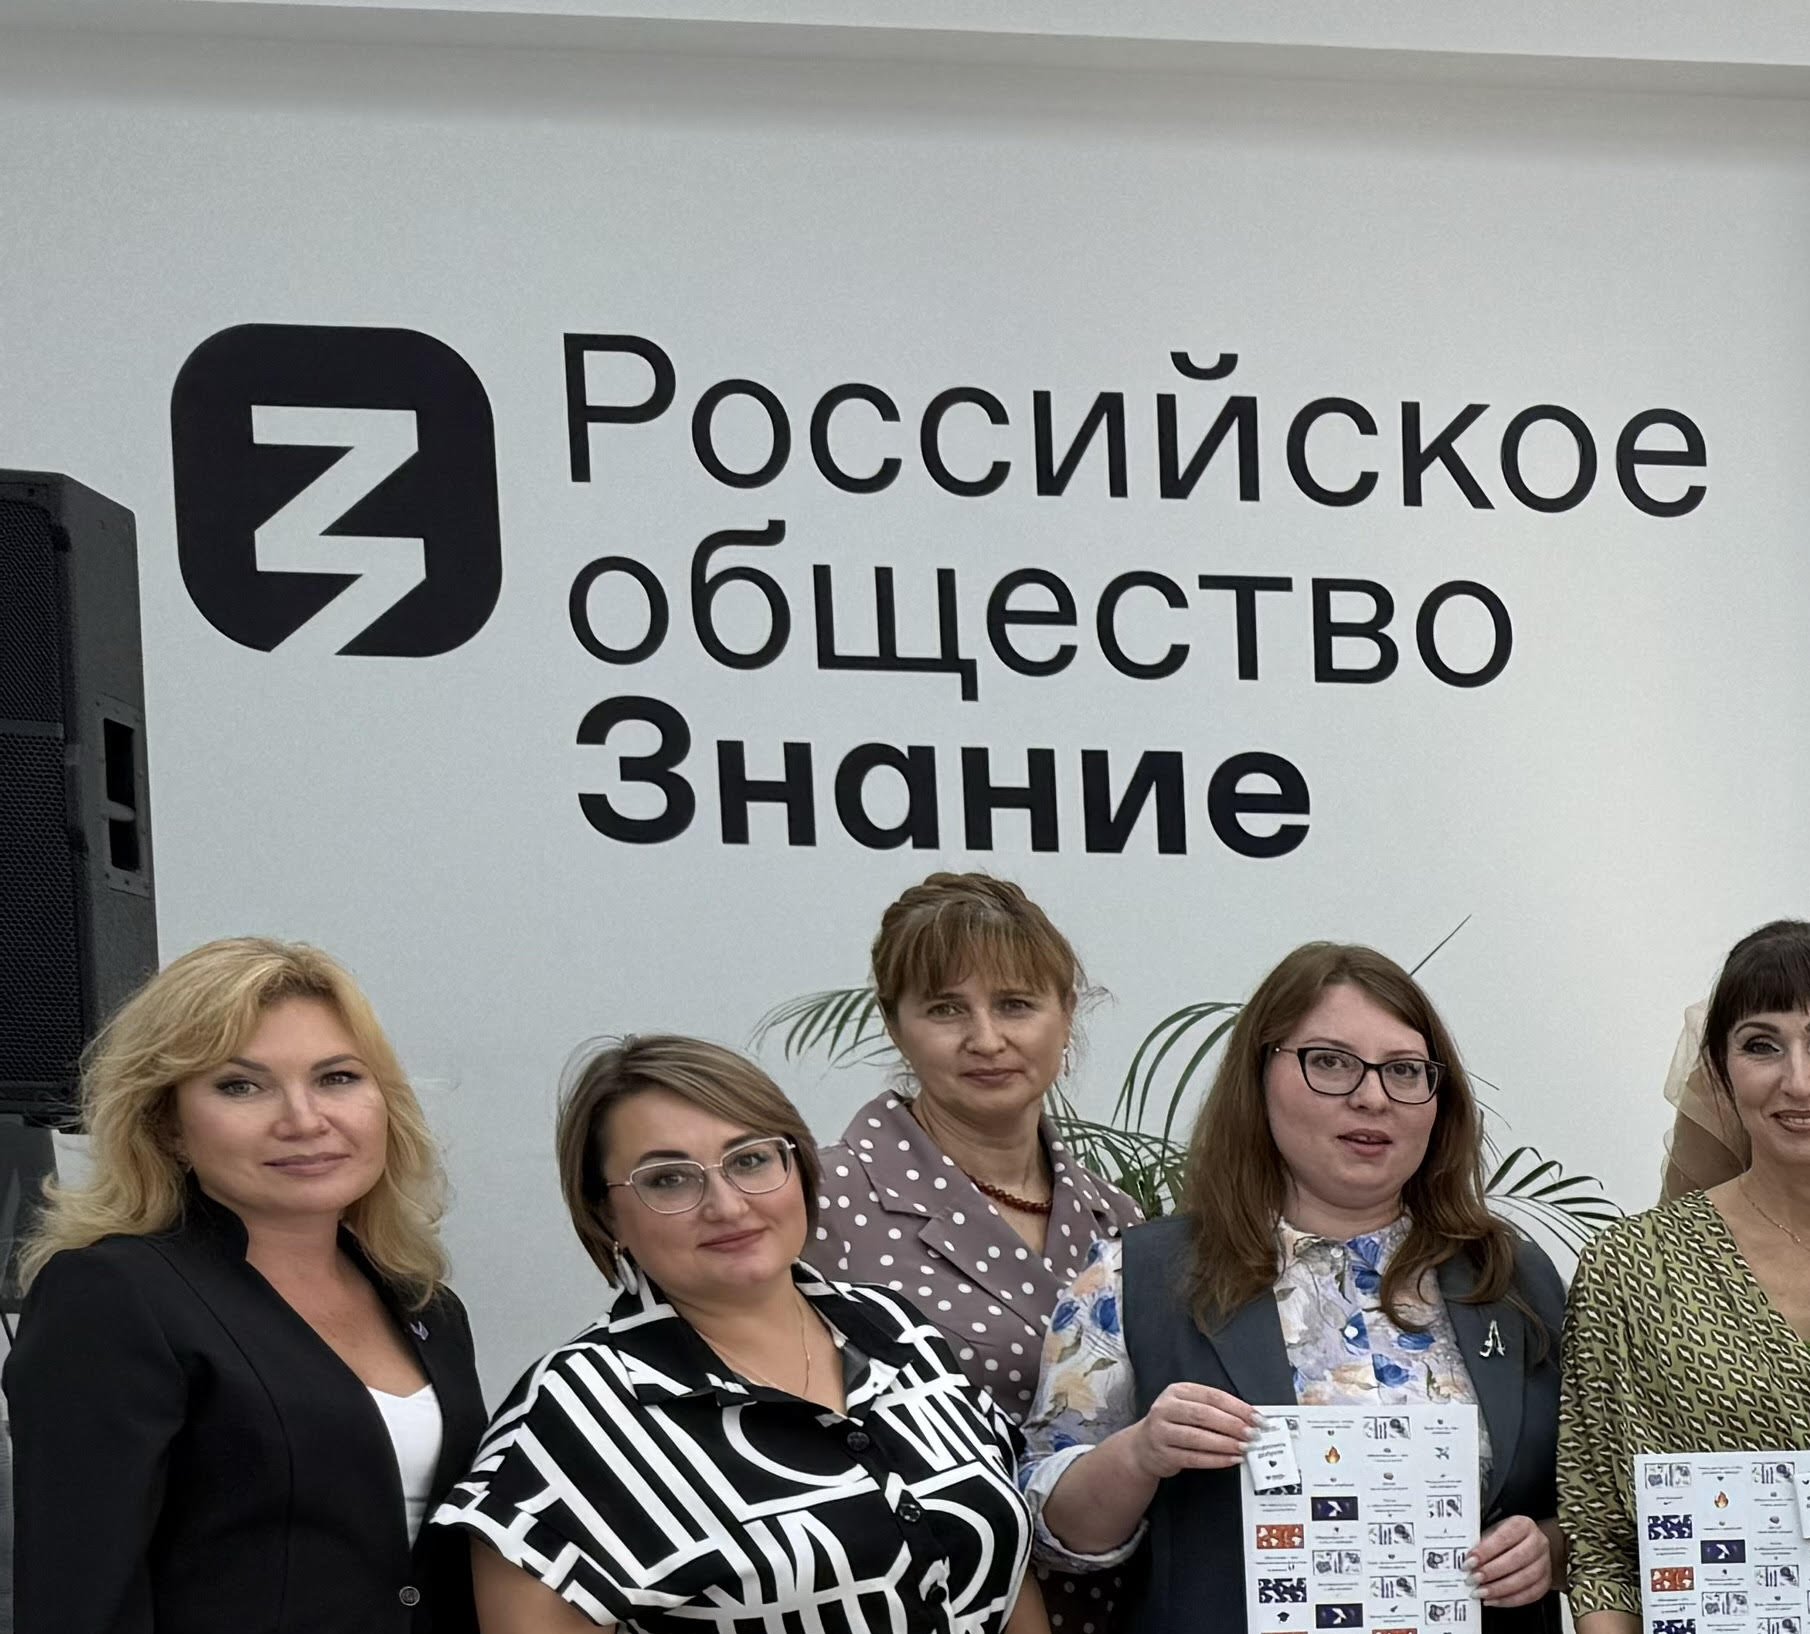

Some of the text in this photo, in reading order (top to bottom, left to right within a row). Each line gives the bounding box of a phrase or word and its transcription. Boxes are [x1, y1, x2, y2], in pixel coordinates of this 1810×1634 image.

[563, 332, 1707, 518] Российское
[568, 519, 1513, 702] общество
[576, 695, 1311, 859] Знание
